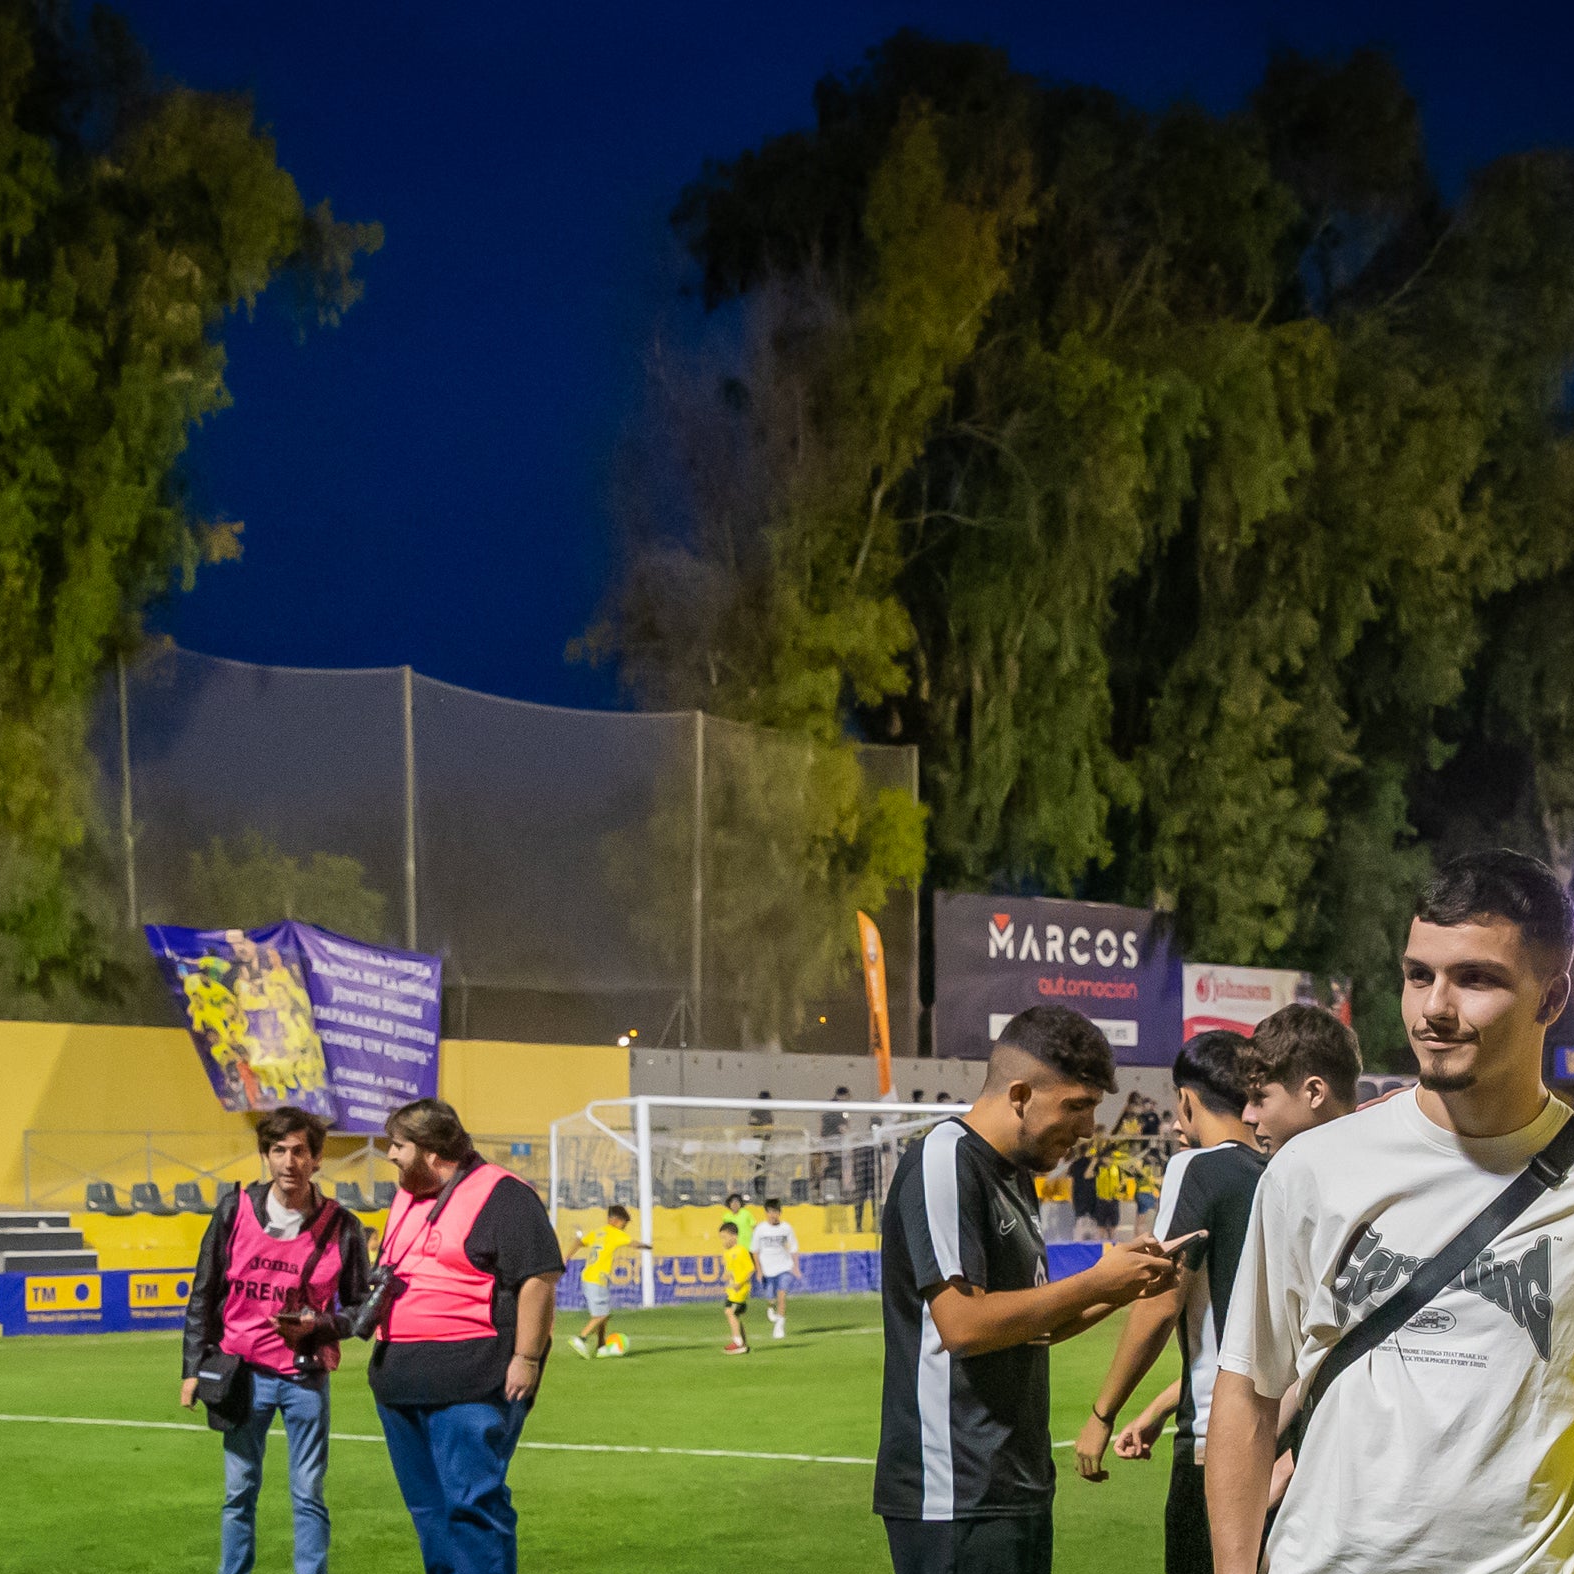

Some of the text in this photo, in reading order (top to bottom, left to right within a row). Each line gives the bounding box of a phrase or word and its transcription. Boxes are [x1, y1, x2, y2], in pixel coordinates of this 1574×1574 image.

[988, 915, 1139, 969] MARCOS
[31, 1286, 56, 1303] TM
[135, 1283, 159, 1300] TM
